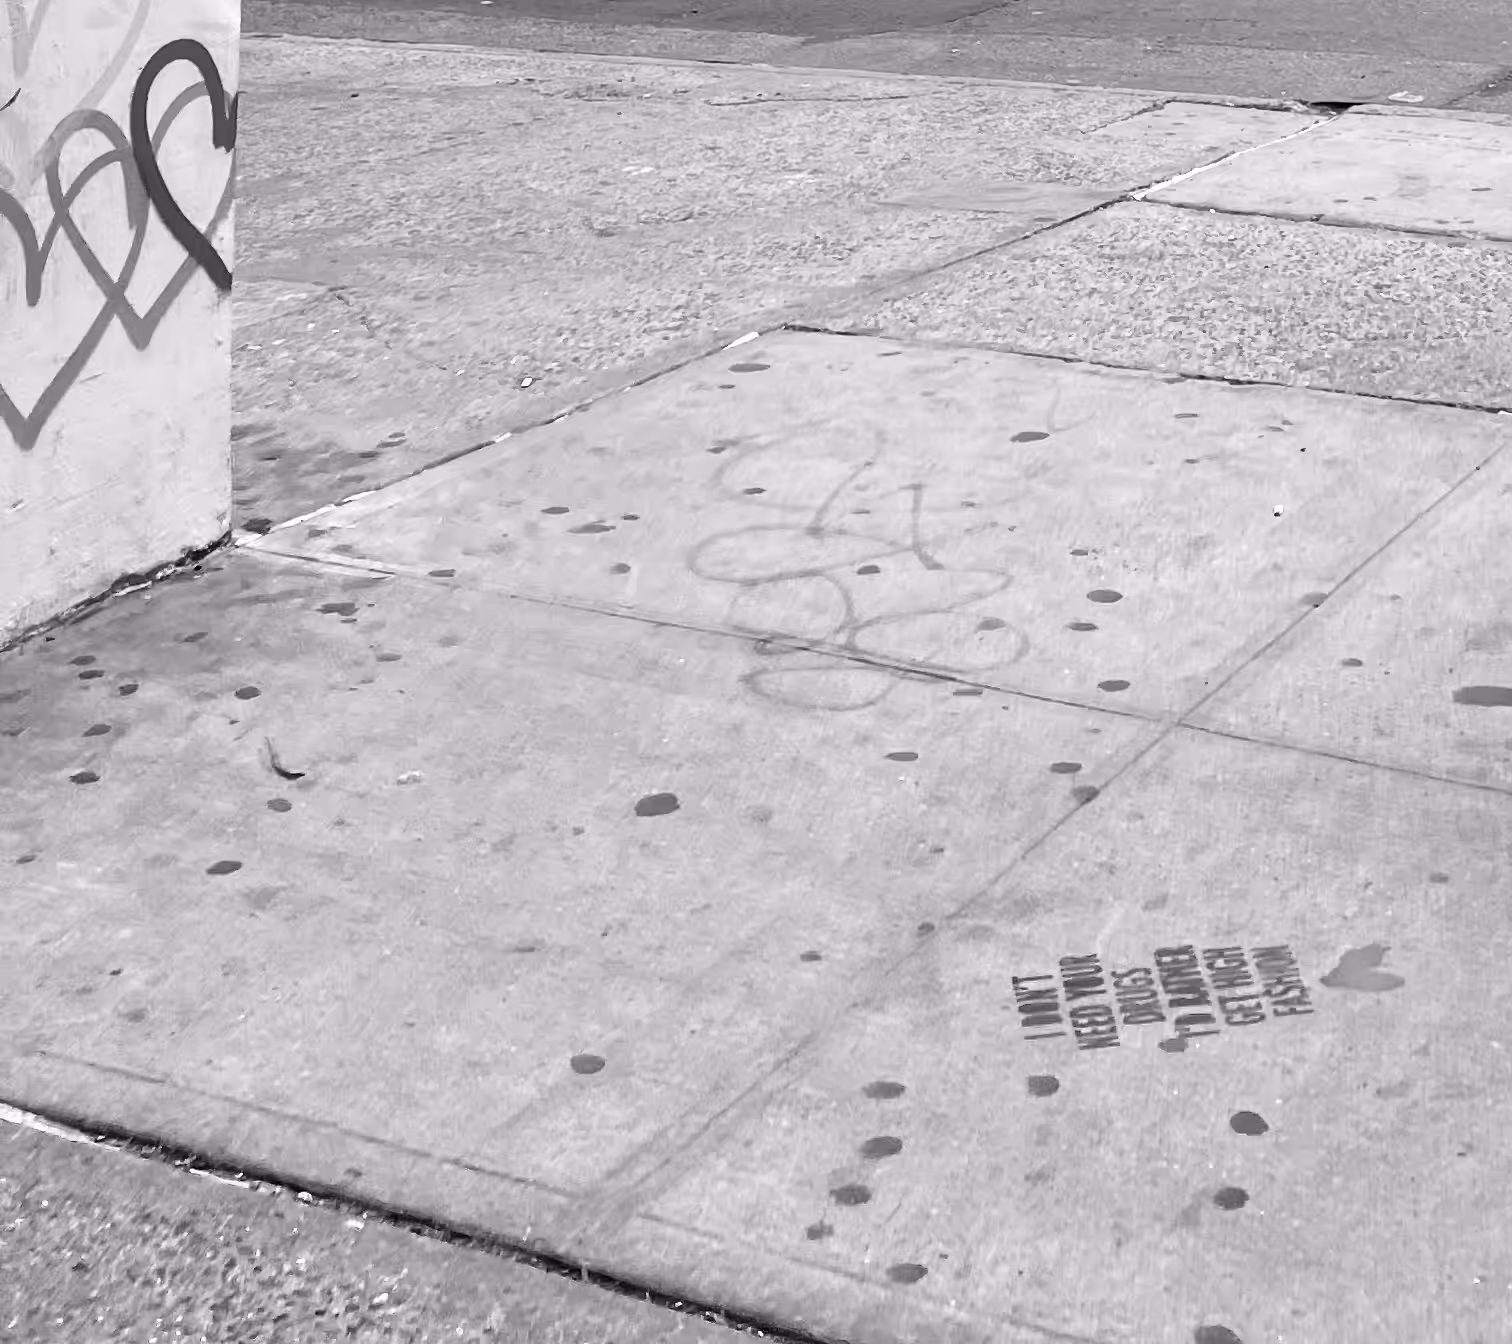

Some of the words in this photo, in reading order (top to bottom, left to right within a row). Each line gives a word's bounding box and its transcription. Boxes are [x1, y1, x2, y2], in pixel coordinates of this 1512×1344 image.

[1058, 953, 1107, 1002] YOUR
[1202, 945, 1255, 990] HIGH
[1110, 967, 1167, 1025] DRUGS
[1218, 994, 1267, 1026] GET
[1069, 1004, 1121, 1051] NEED
